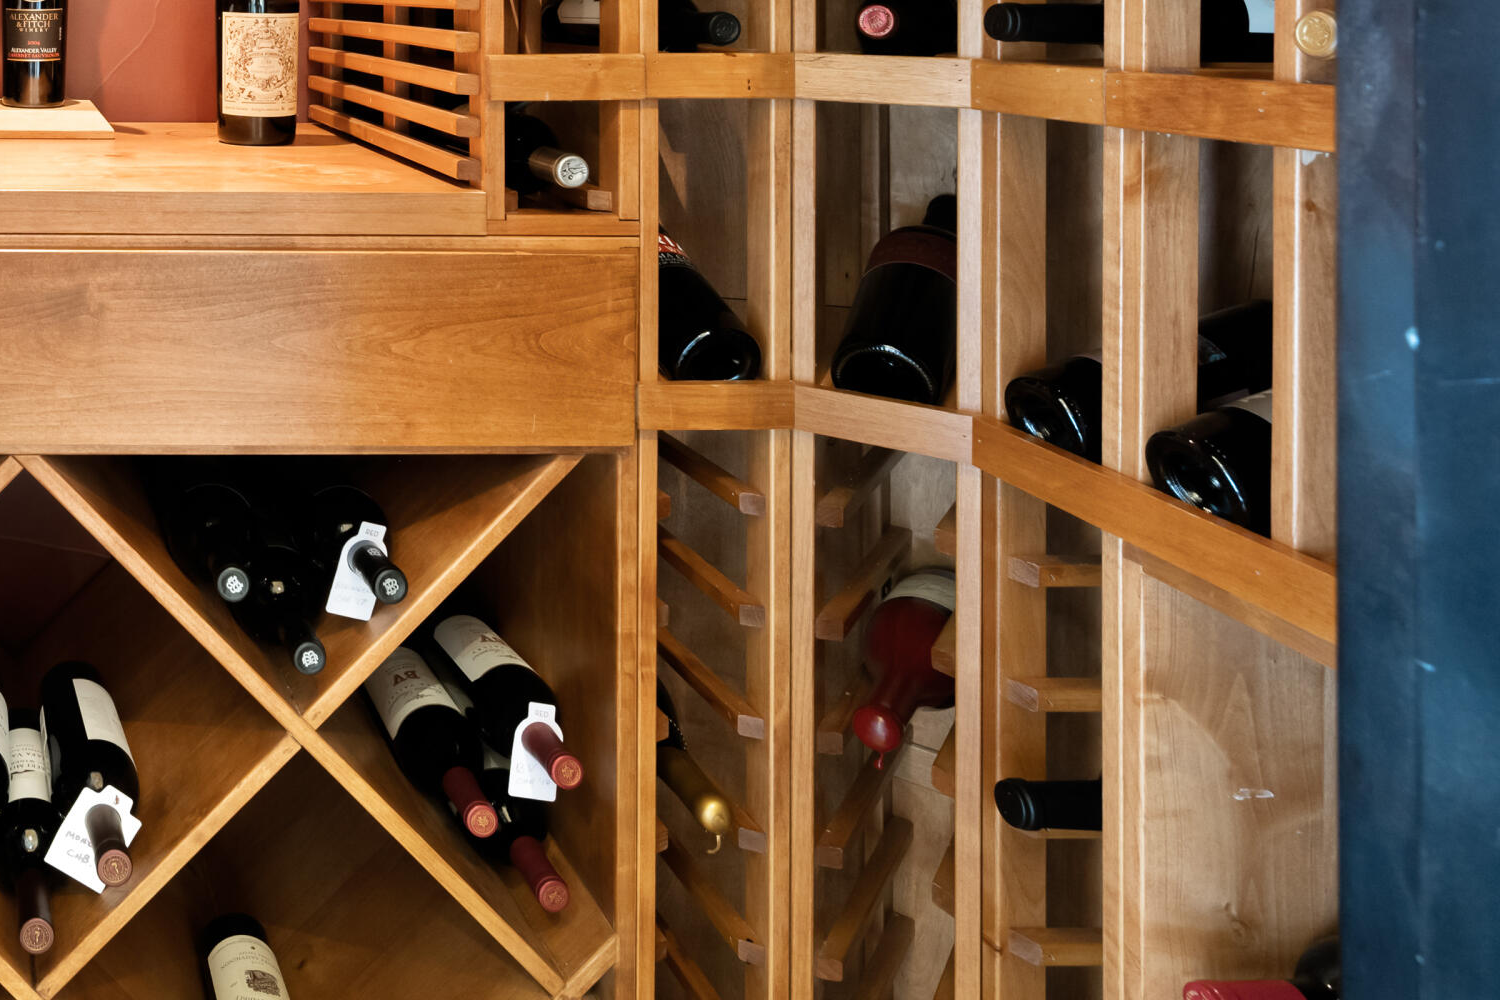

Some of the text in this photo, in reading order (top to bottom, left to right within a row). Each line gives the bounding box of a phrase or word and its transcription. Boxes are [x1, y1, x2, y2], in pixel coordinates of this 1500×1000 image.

[9, 12, 59, 21] ALEXANDER
[364, 528, 379, 537] RED
[392, 670, 420, 686] BV
